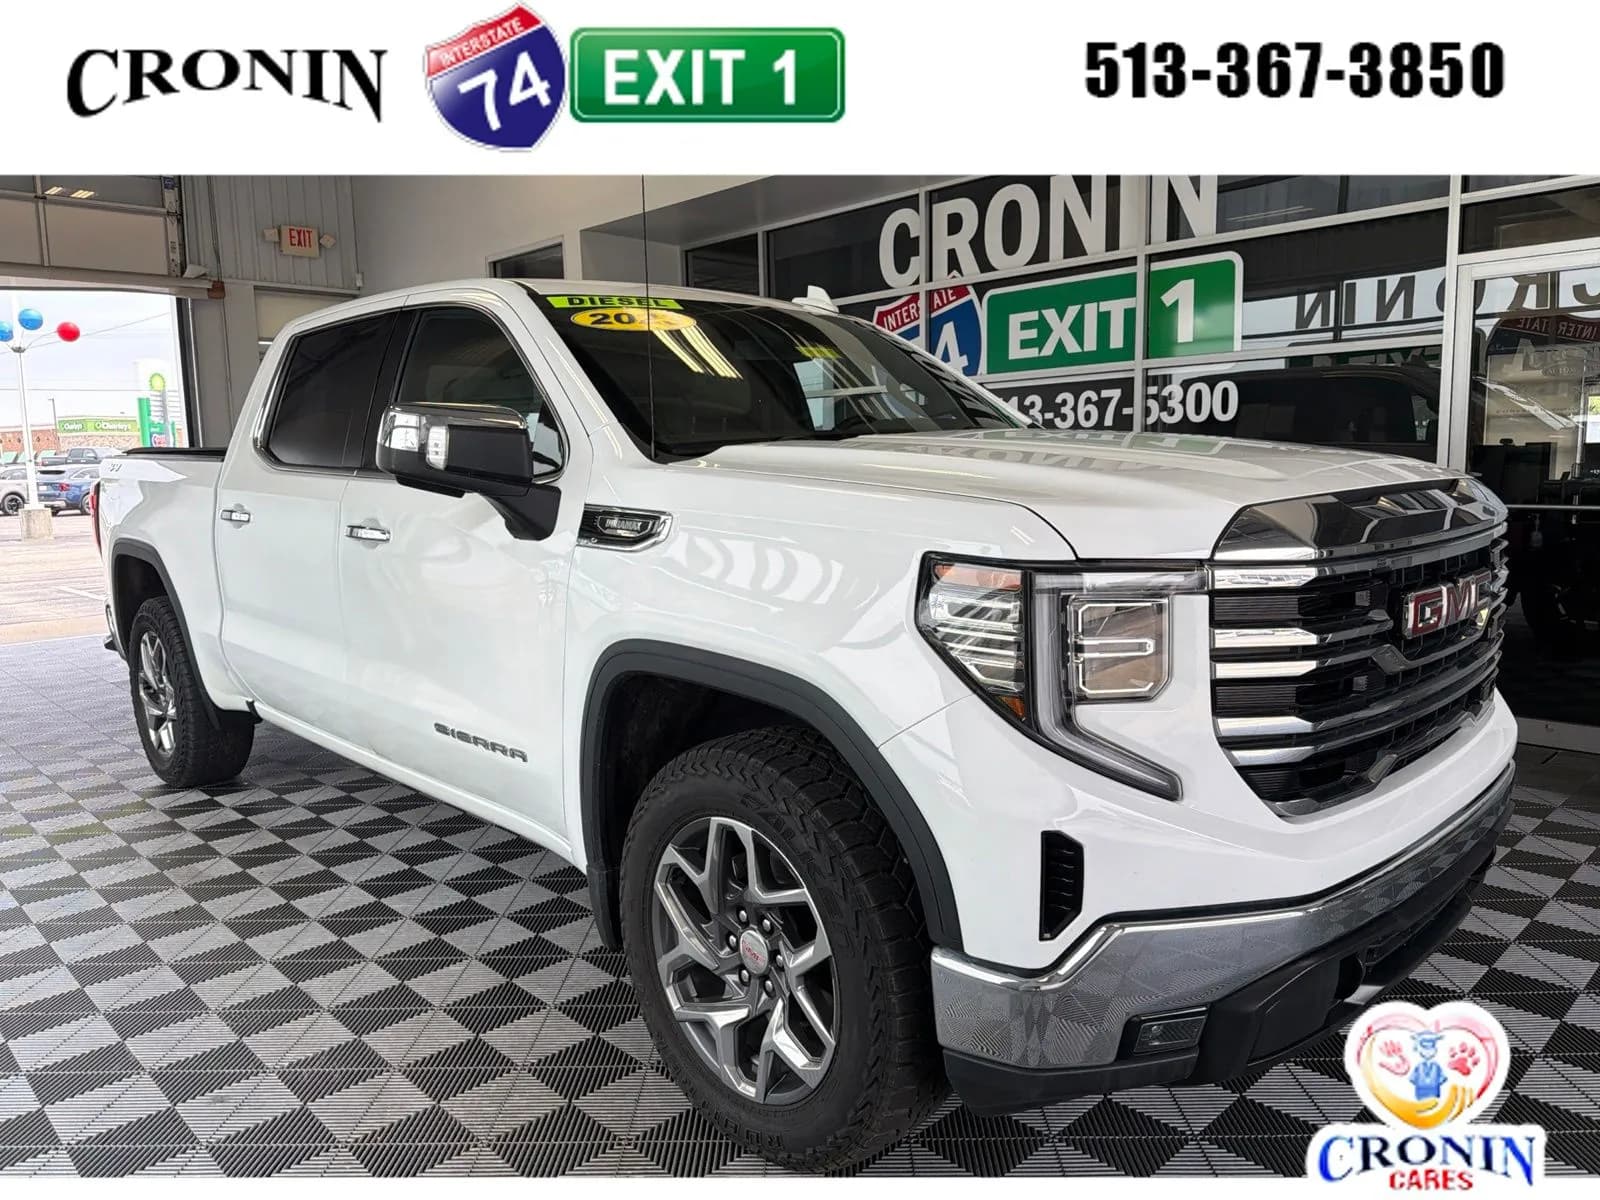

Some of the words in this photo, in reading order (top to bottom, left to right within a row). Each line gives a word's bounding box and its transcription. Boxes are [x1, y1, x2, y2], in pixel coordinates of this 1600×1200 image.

[289, 228, 313, 248] EXIT
[878, 174, 1218, 289] CRONIN
[567, 296, 667, 308] DIESEL
[883, 288, 957, 331] INTERATE
[1008, 297, 1137, 360] EXIT
[1161, 278, 1195, 343] 1
[1006, 380, 1239, 431] 13-367-5300
[1403, 570, 1491, 639] GMC
[434, 722, 528, 762] SIERRA
